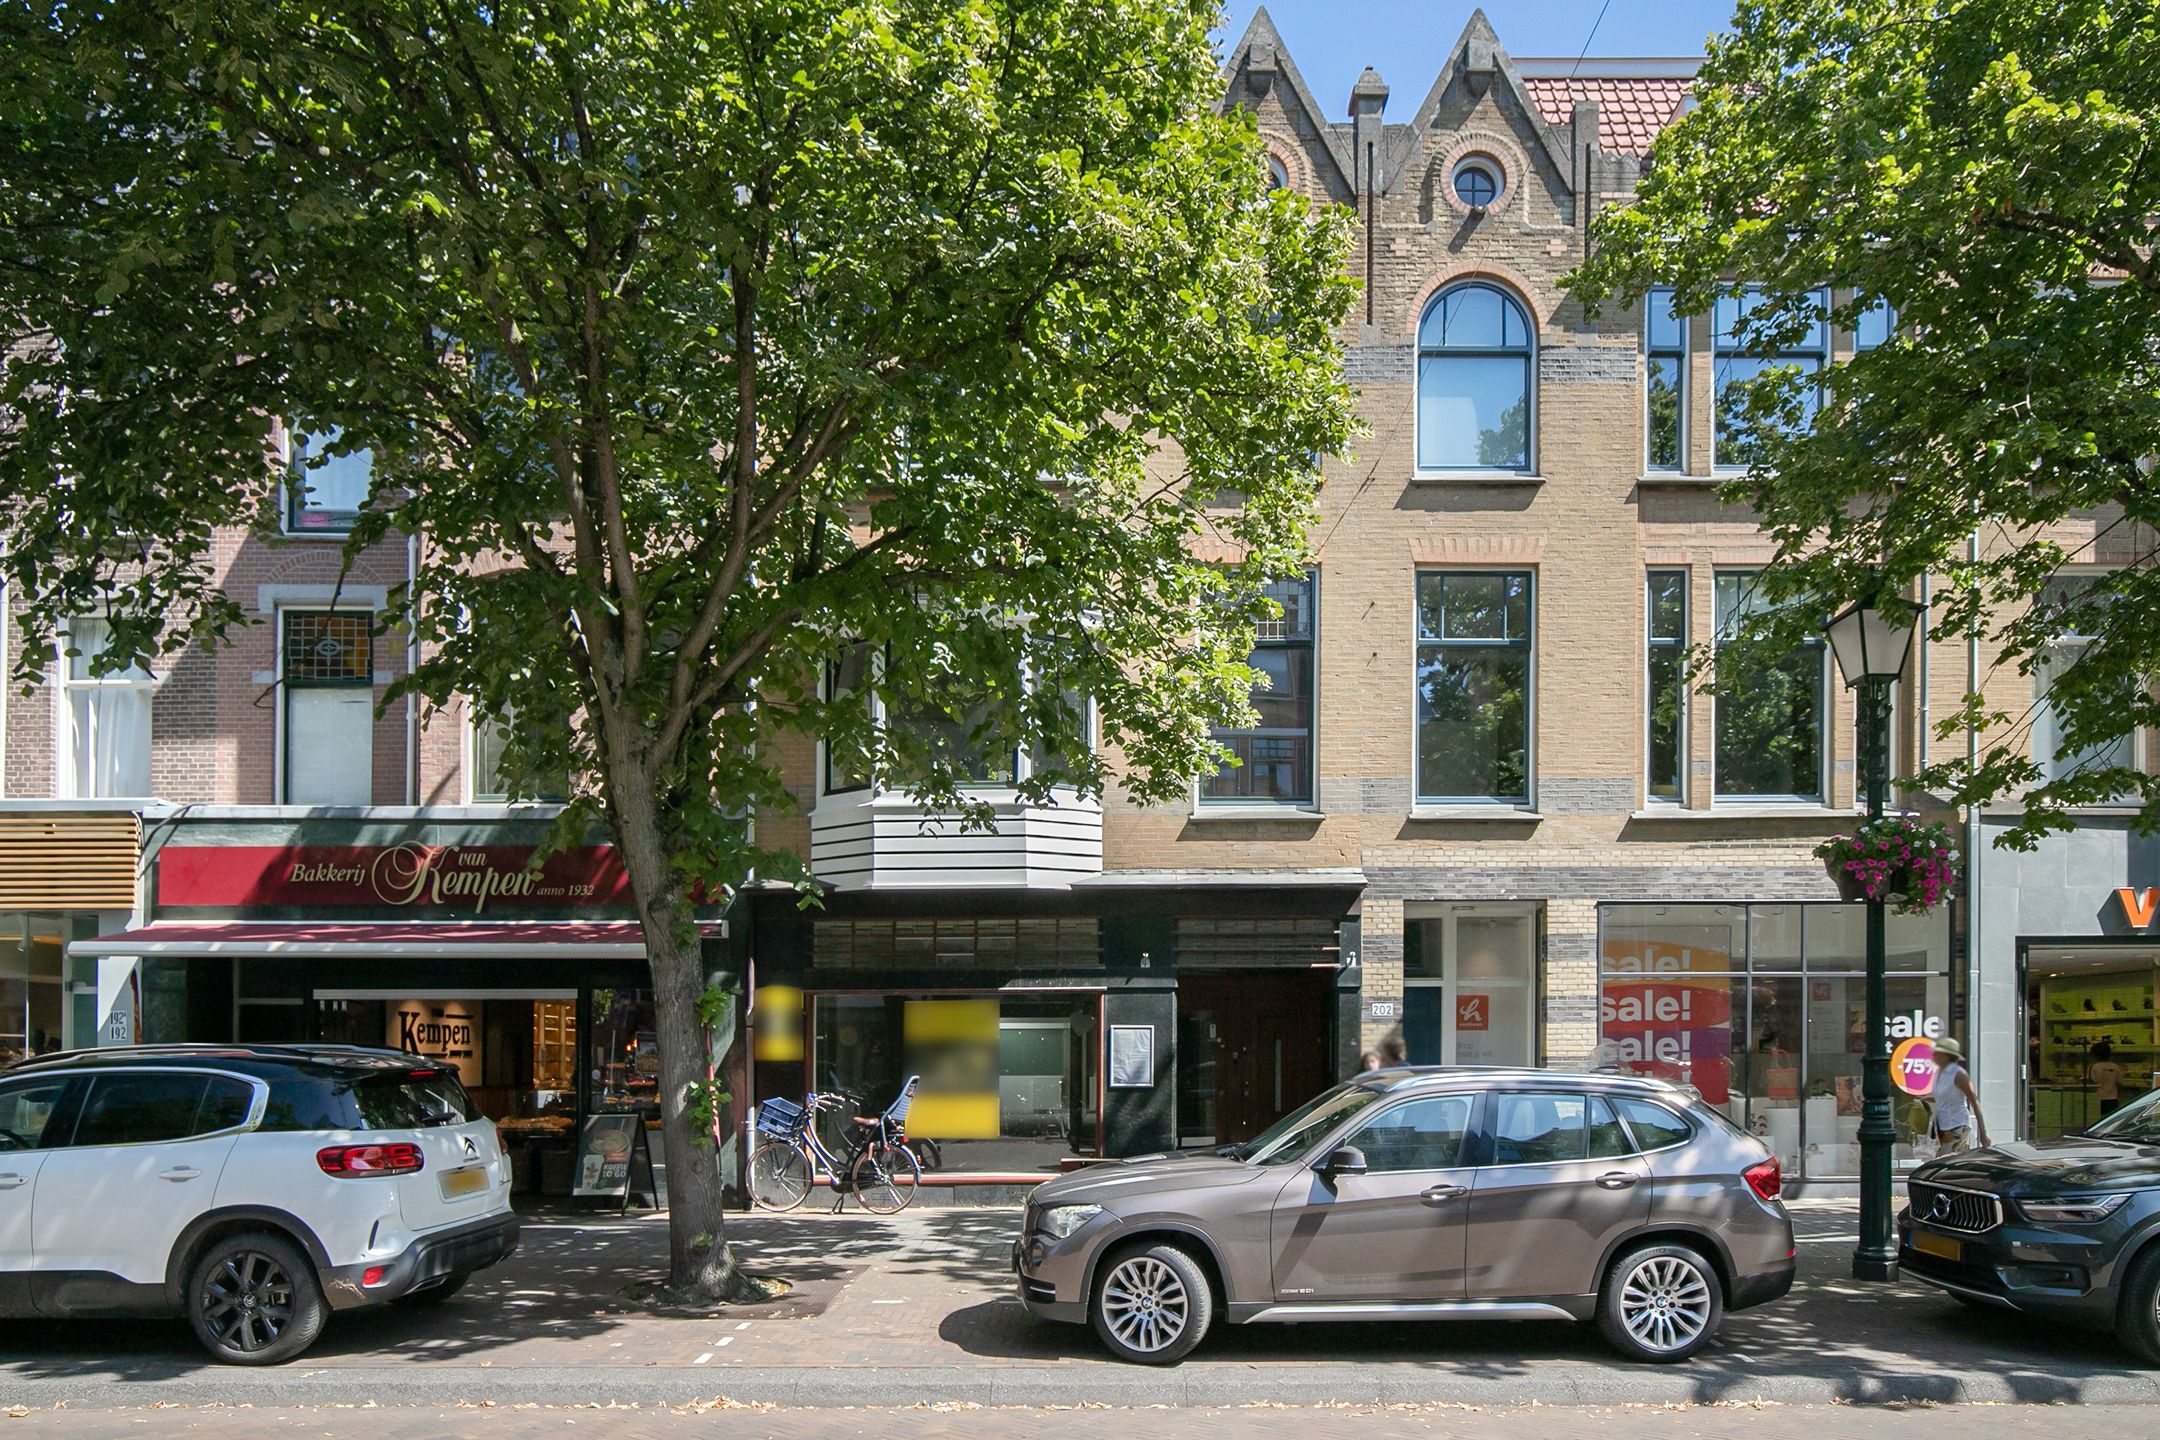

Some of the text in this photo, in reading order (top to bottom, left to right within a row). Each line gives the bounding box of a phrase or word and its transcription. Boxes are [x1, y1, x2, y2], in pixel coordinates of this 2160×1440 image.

[289, 840, 595, 914] Bakkerij van Kempen anno 1932
[1373, 1005, 1392, 1015] 202
[1603, 989, 1691, 1022] sale!
[111, 1026, 126, 1040] 192
[398, 1011, 471, 1056] Kempen
